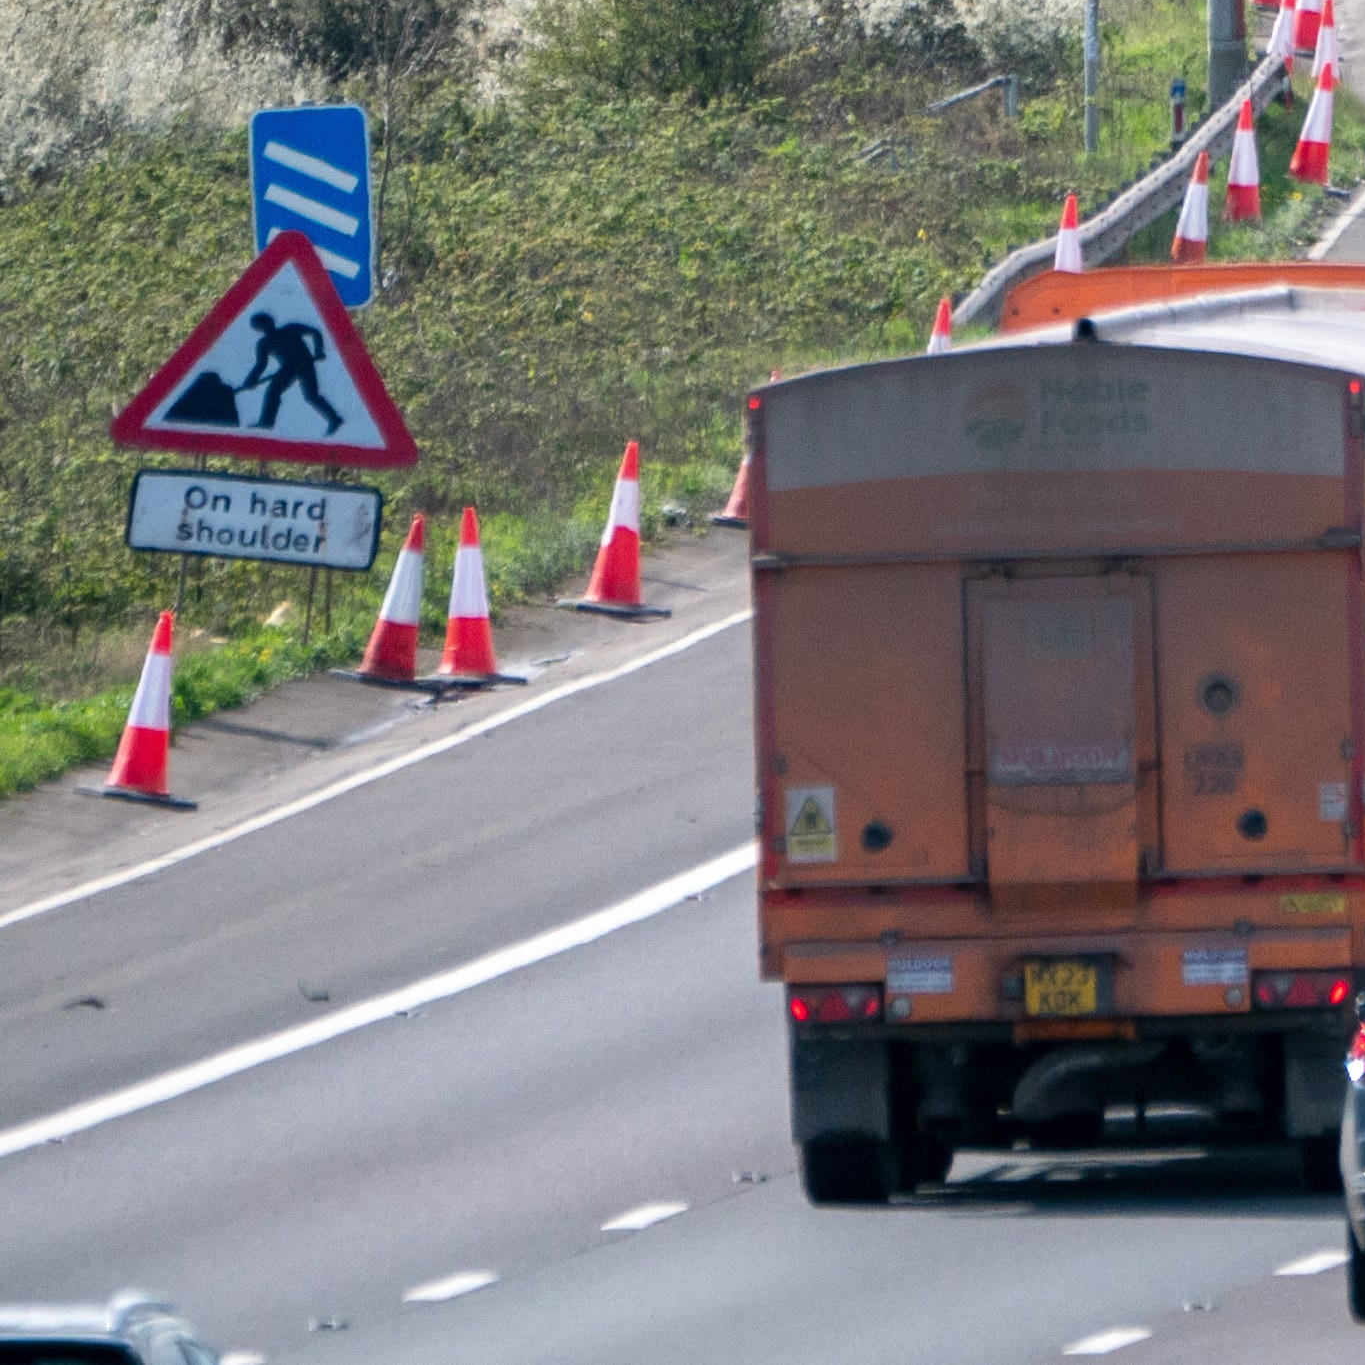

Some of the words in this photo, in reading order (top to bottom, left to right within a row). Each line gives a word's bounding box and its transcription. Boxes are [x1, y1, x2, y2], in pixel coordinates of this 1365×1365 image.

[184, 485, 232, 514] On
[248, 492, 326, 521] hard
[176, 518, 326, 554] shoulder
